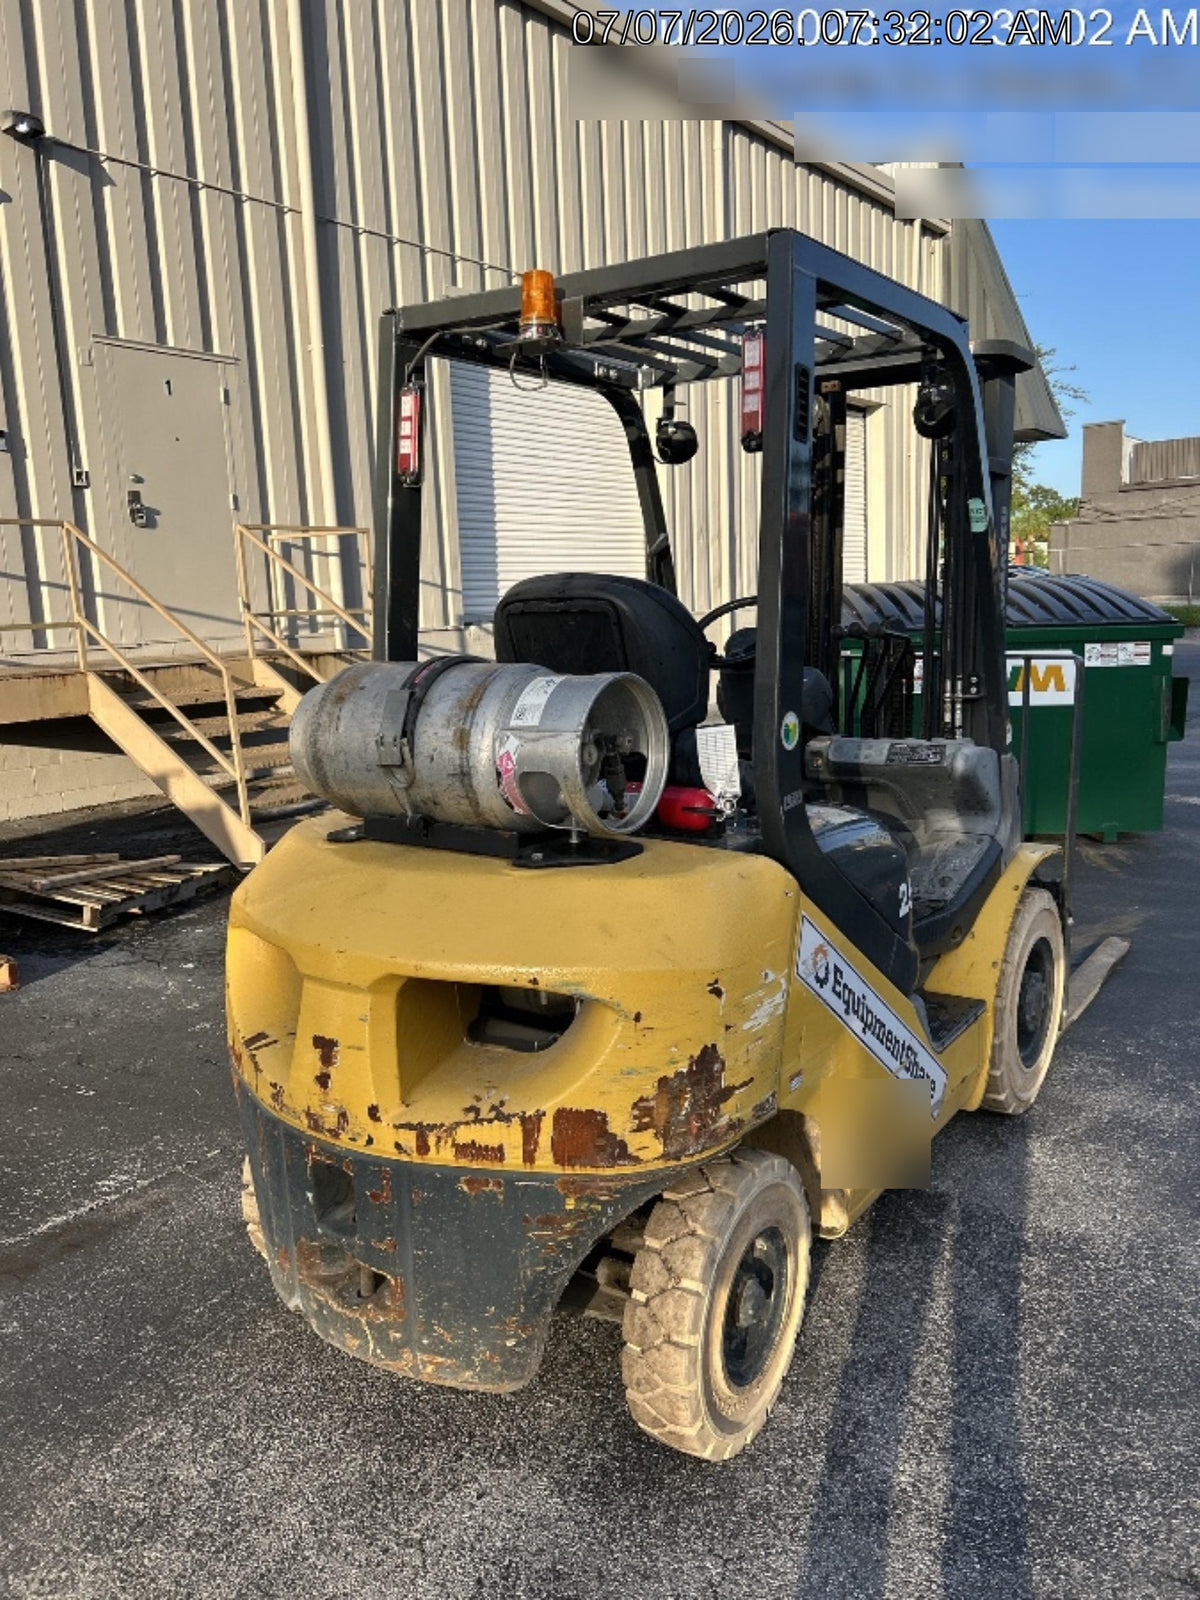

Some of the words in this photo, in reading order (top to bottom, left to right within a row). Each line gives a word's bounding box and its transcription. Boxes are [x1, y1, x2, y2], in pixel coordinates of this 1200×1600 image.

[164, 379, 172, 396] 1
[898, 882, 913, 918] 2
[831, 962, 936, 1099] EquipmentShae
